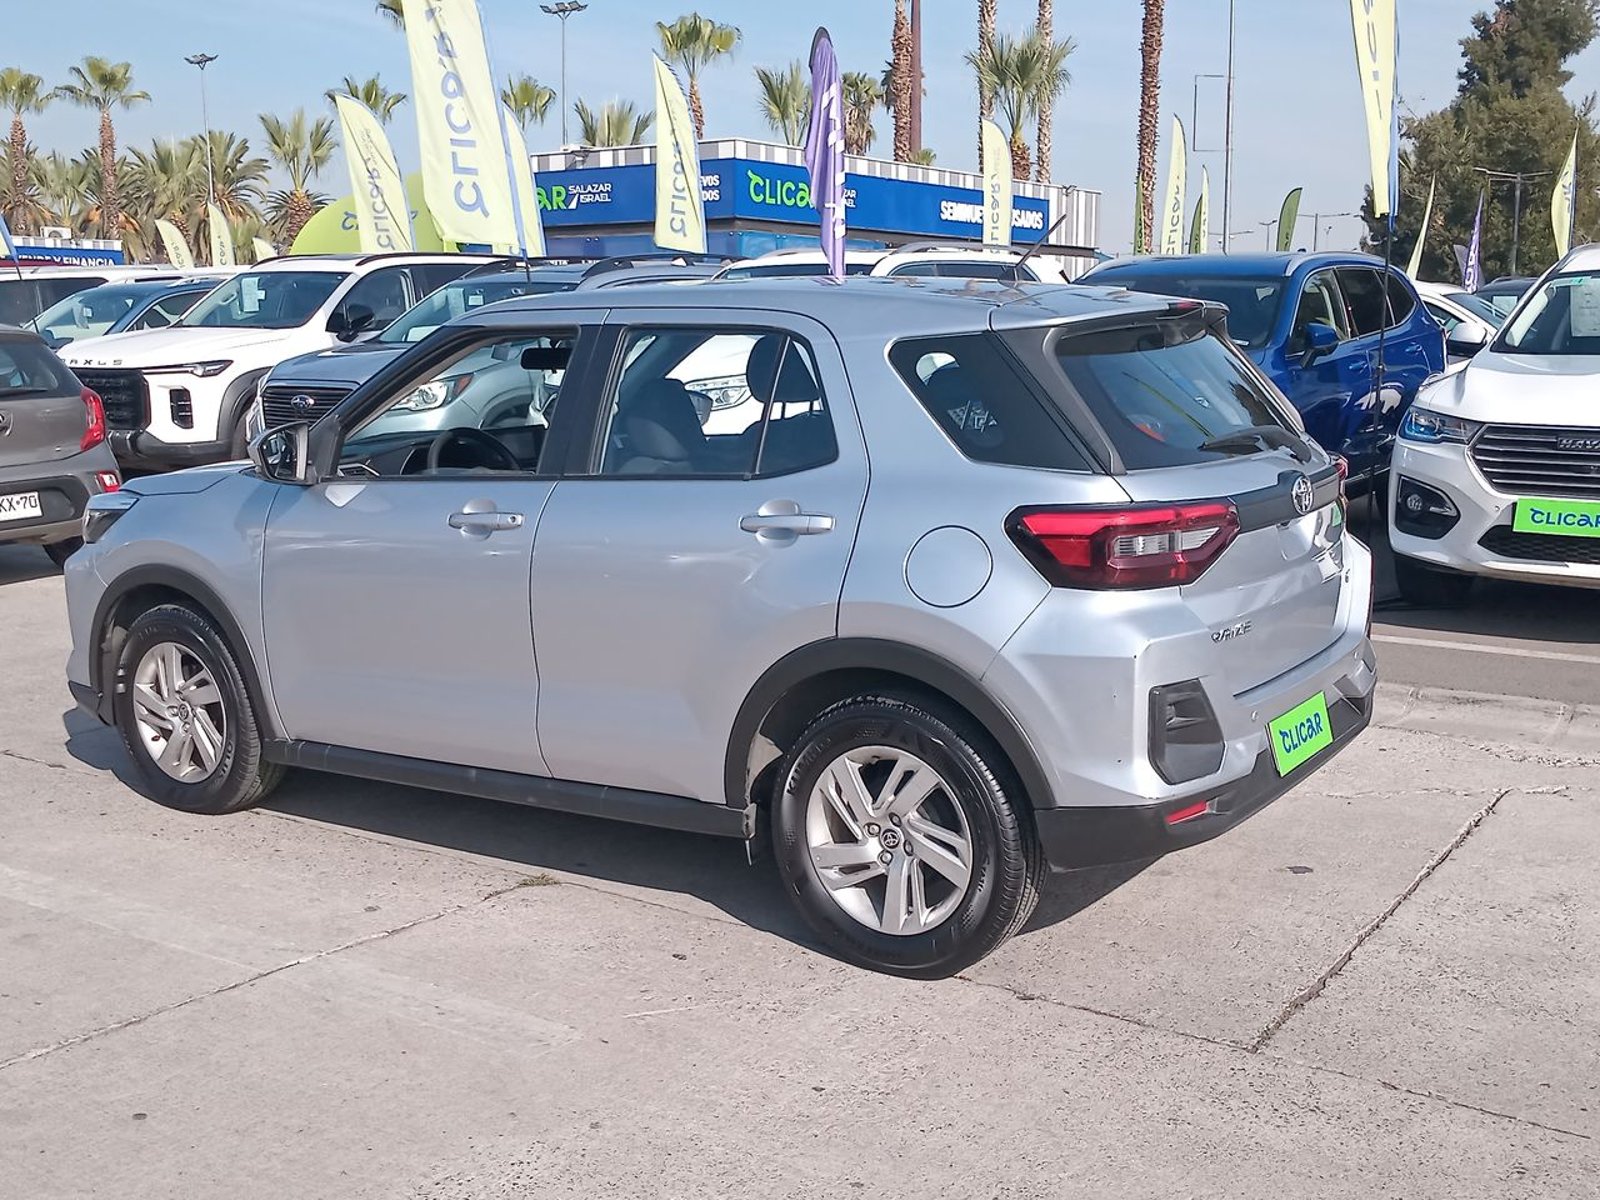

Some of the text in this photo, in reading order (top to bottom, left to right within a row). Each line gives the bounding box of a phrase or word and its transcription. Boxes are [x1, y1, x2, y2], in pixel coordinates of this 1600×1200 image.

[568, 183, 612, 194] SALAZAR
[579, 193, 612, 203] ISRAEL
[940, 200, 984, 224] SEMINUE
